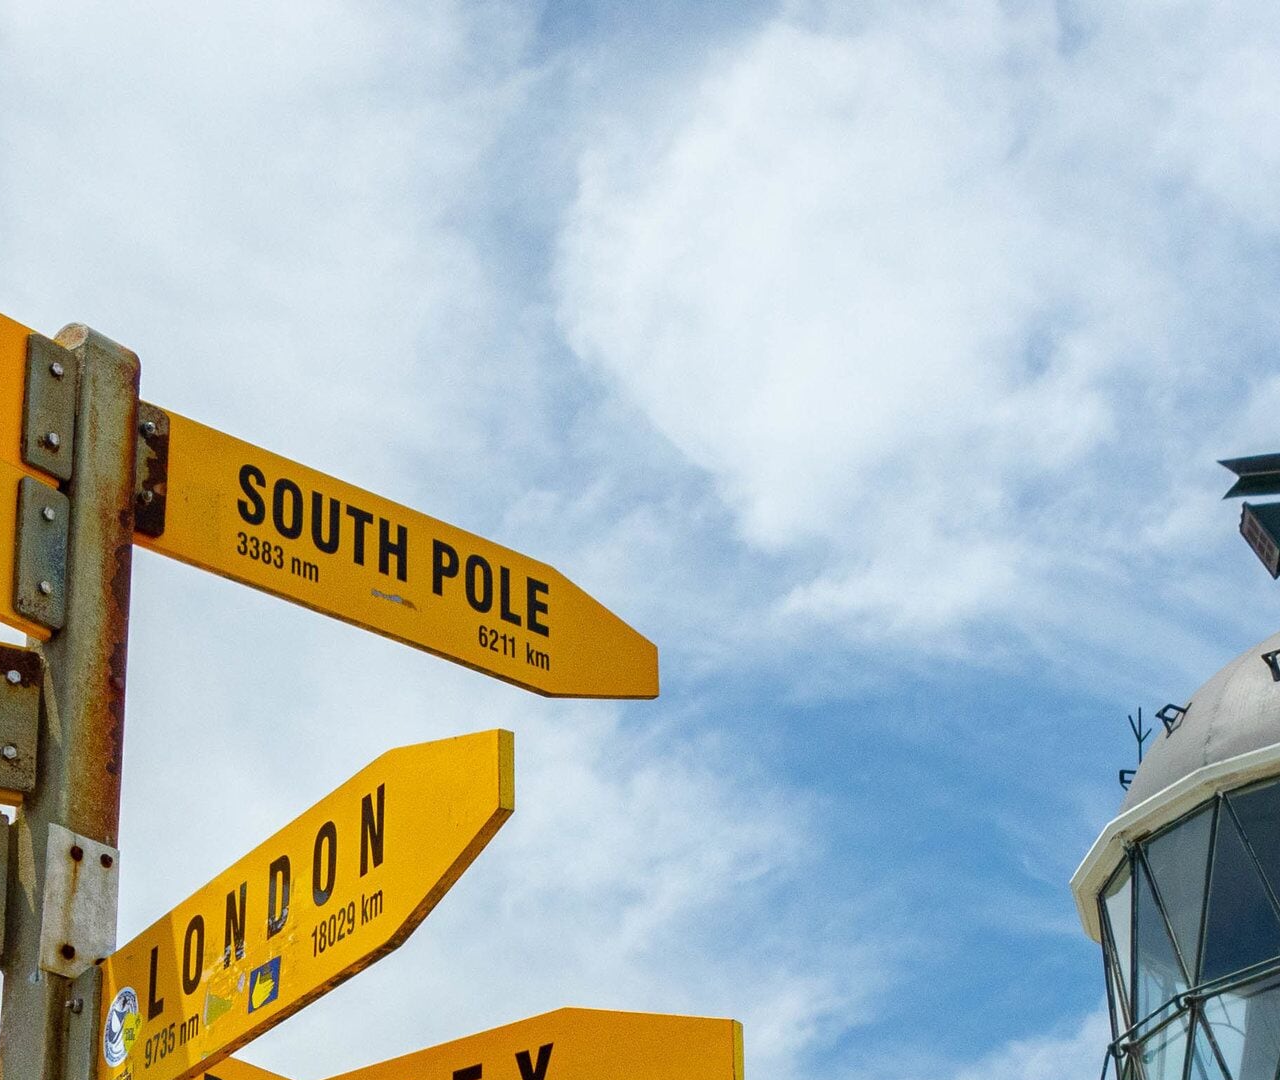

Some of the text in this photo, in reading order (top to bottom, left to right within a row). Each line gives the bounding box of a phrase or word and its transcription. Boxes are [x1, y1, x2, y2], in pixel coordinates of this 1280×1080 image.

[237, 463, 551, 638] SOUTH POLE
[237, 530, 320, 583] 3383 nm
[477, 624, 551, 671] 6211 km
[146, 783, 386, 1021] LONDON
[310, 887, 384, 958] 18029 km
[144, 1012, 200, 1069] 9735 nm
